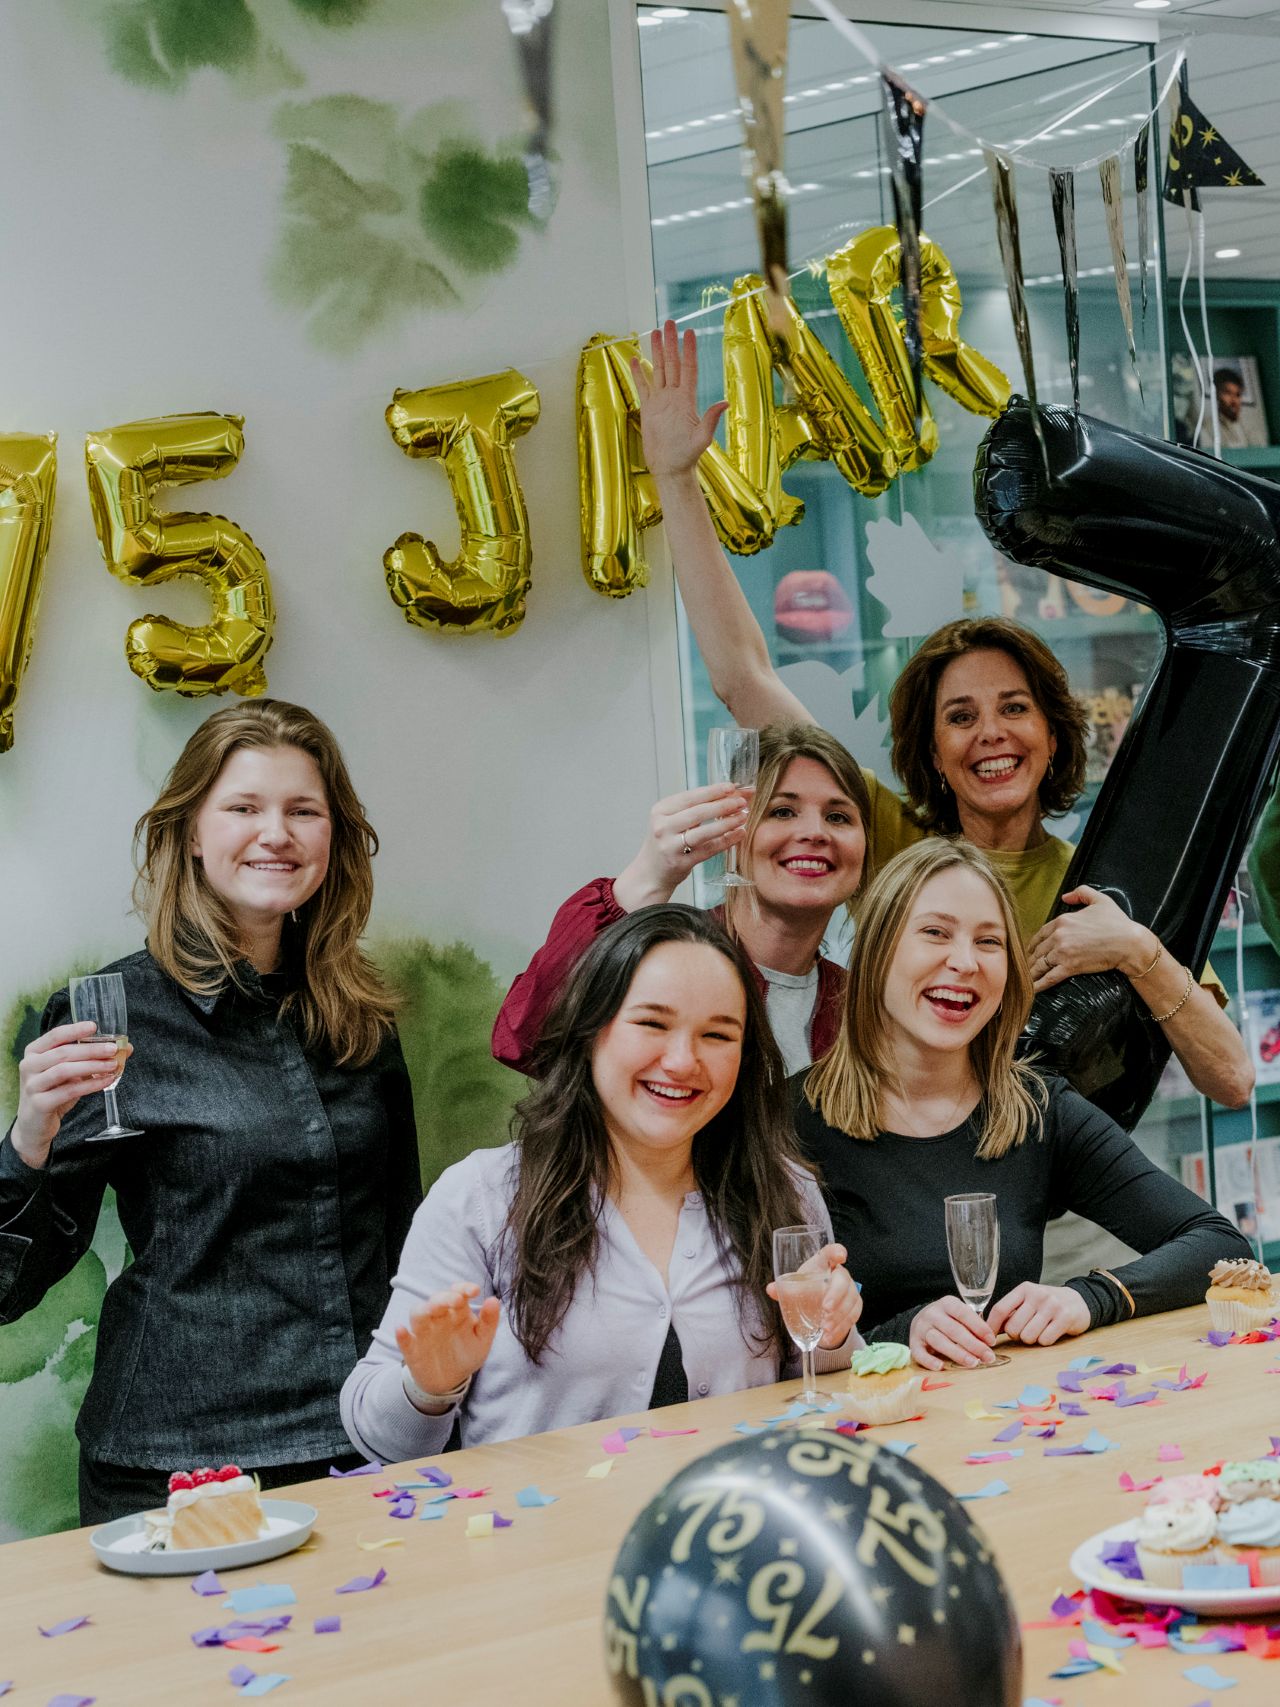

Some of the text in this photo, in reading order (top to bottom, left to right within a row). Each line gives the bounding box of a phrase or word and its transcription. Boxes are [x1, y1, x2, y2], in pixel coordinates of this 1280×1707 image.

[384, 223, 1012, 640] JAAR
[670, 1488, 767, 1564] 75
[856, 1485, 948, 1588] 75
[740, 1559, 846, 1661] 75
